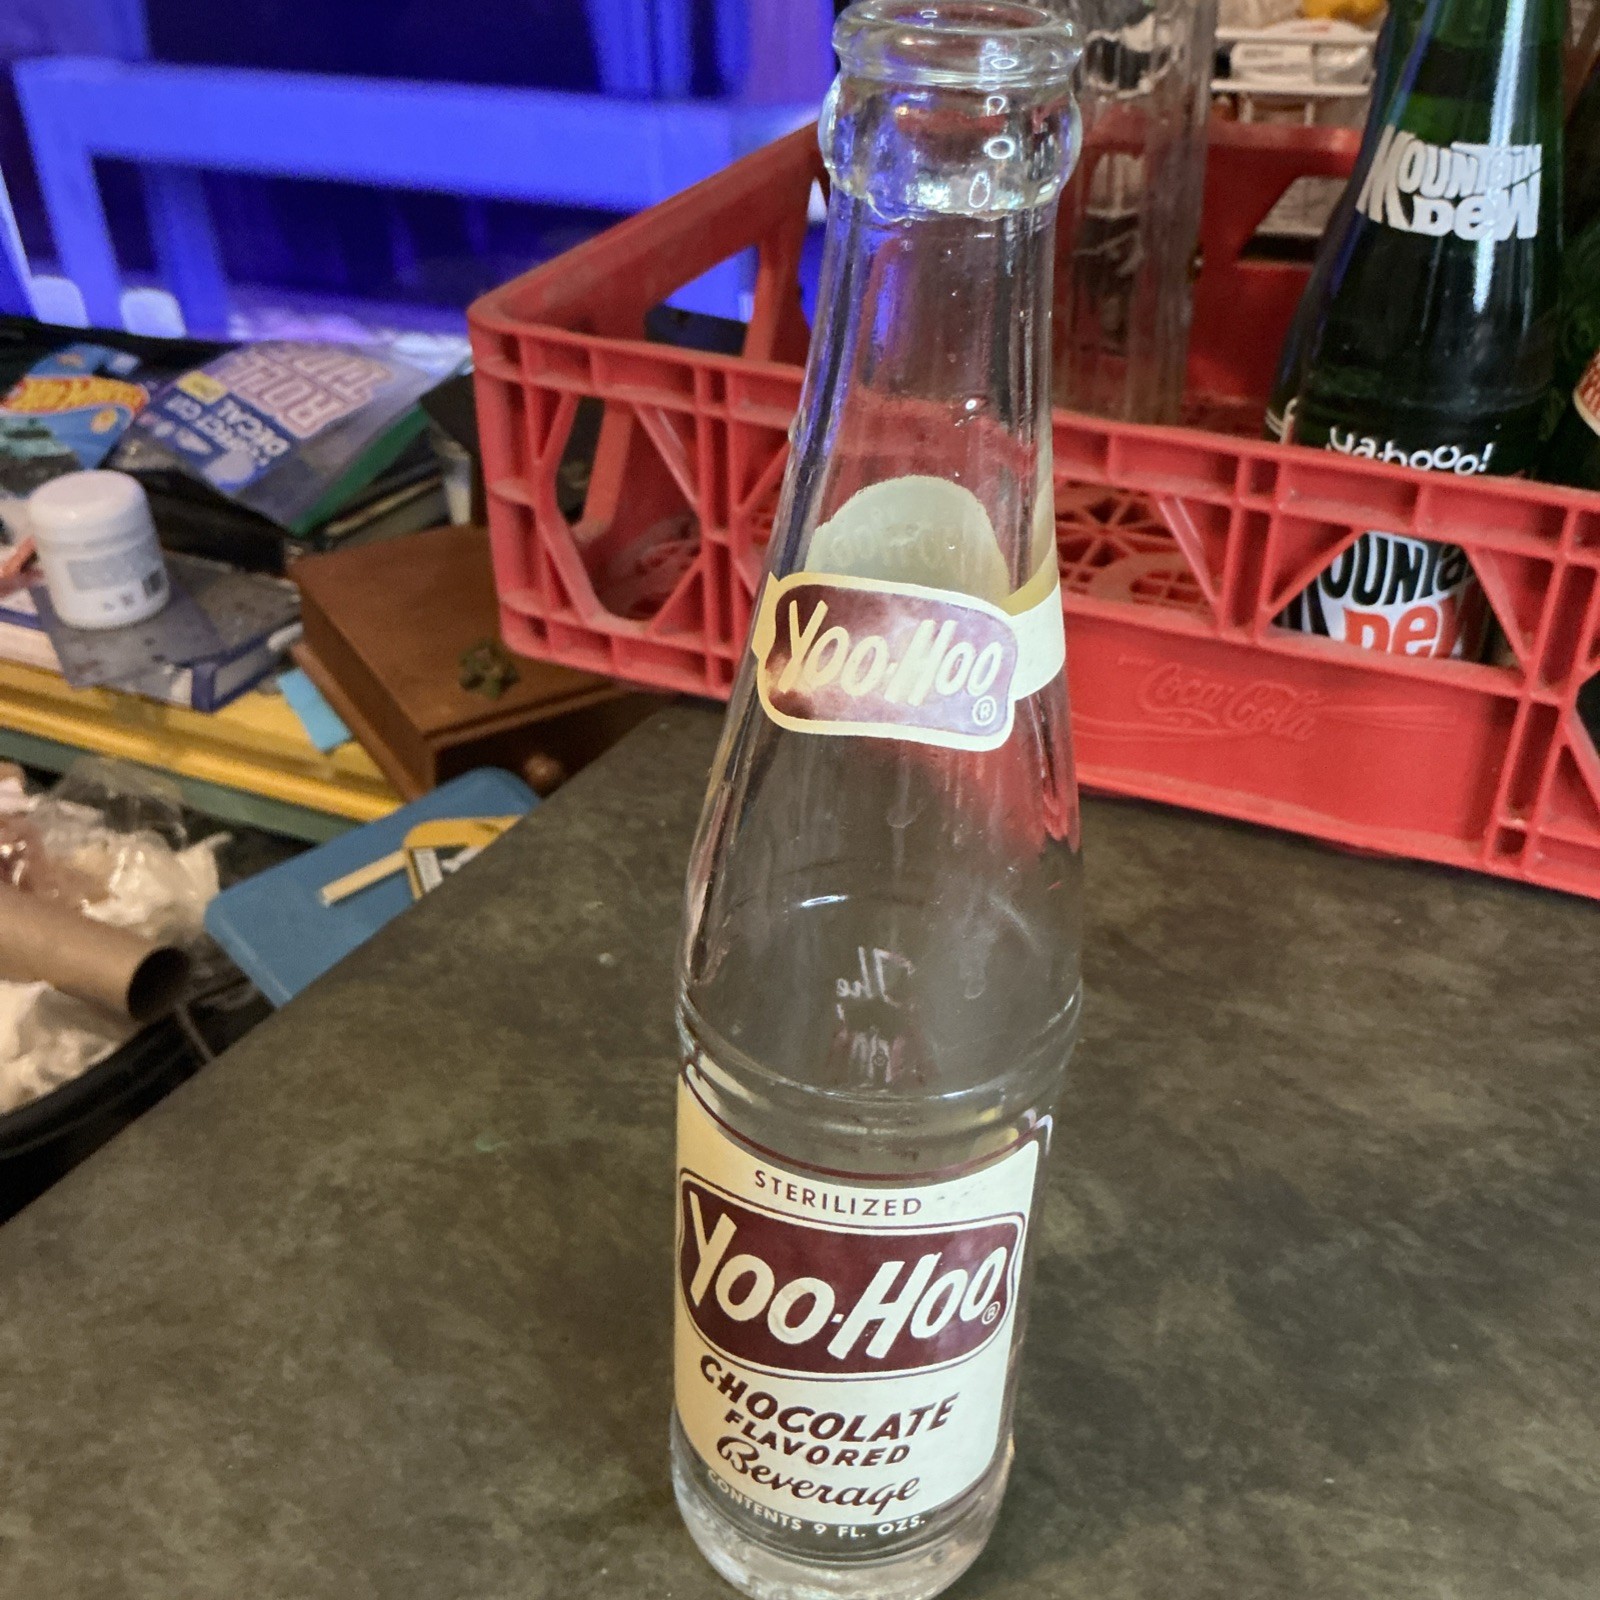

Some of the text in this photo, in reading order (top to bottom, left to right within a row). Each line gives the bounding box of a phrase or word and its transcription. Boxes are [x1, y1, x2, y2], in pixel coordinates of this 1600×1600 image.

[777, 600, 1003, 706] Yoo-Hoo
[754, 1169, 923, 1217] STERILIZED
[688, 1190, 1008, 1361] Yoo-Hoo
[700, 1354, 961, 1443] CHOCOLATE
[723, 1409, 911, 1467] FLAVORED
[706, 1468, 926, 1539] CONTENTS 9 FL. OZS.
[716, 1435, 921, 1517] Beverage
